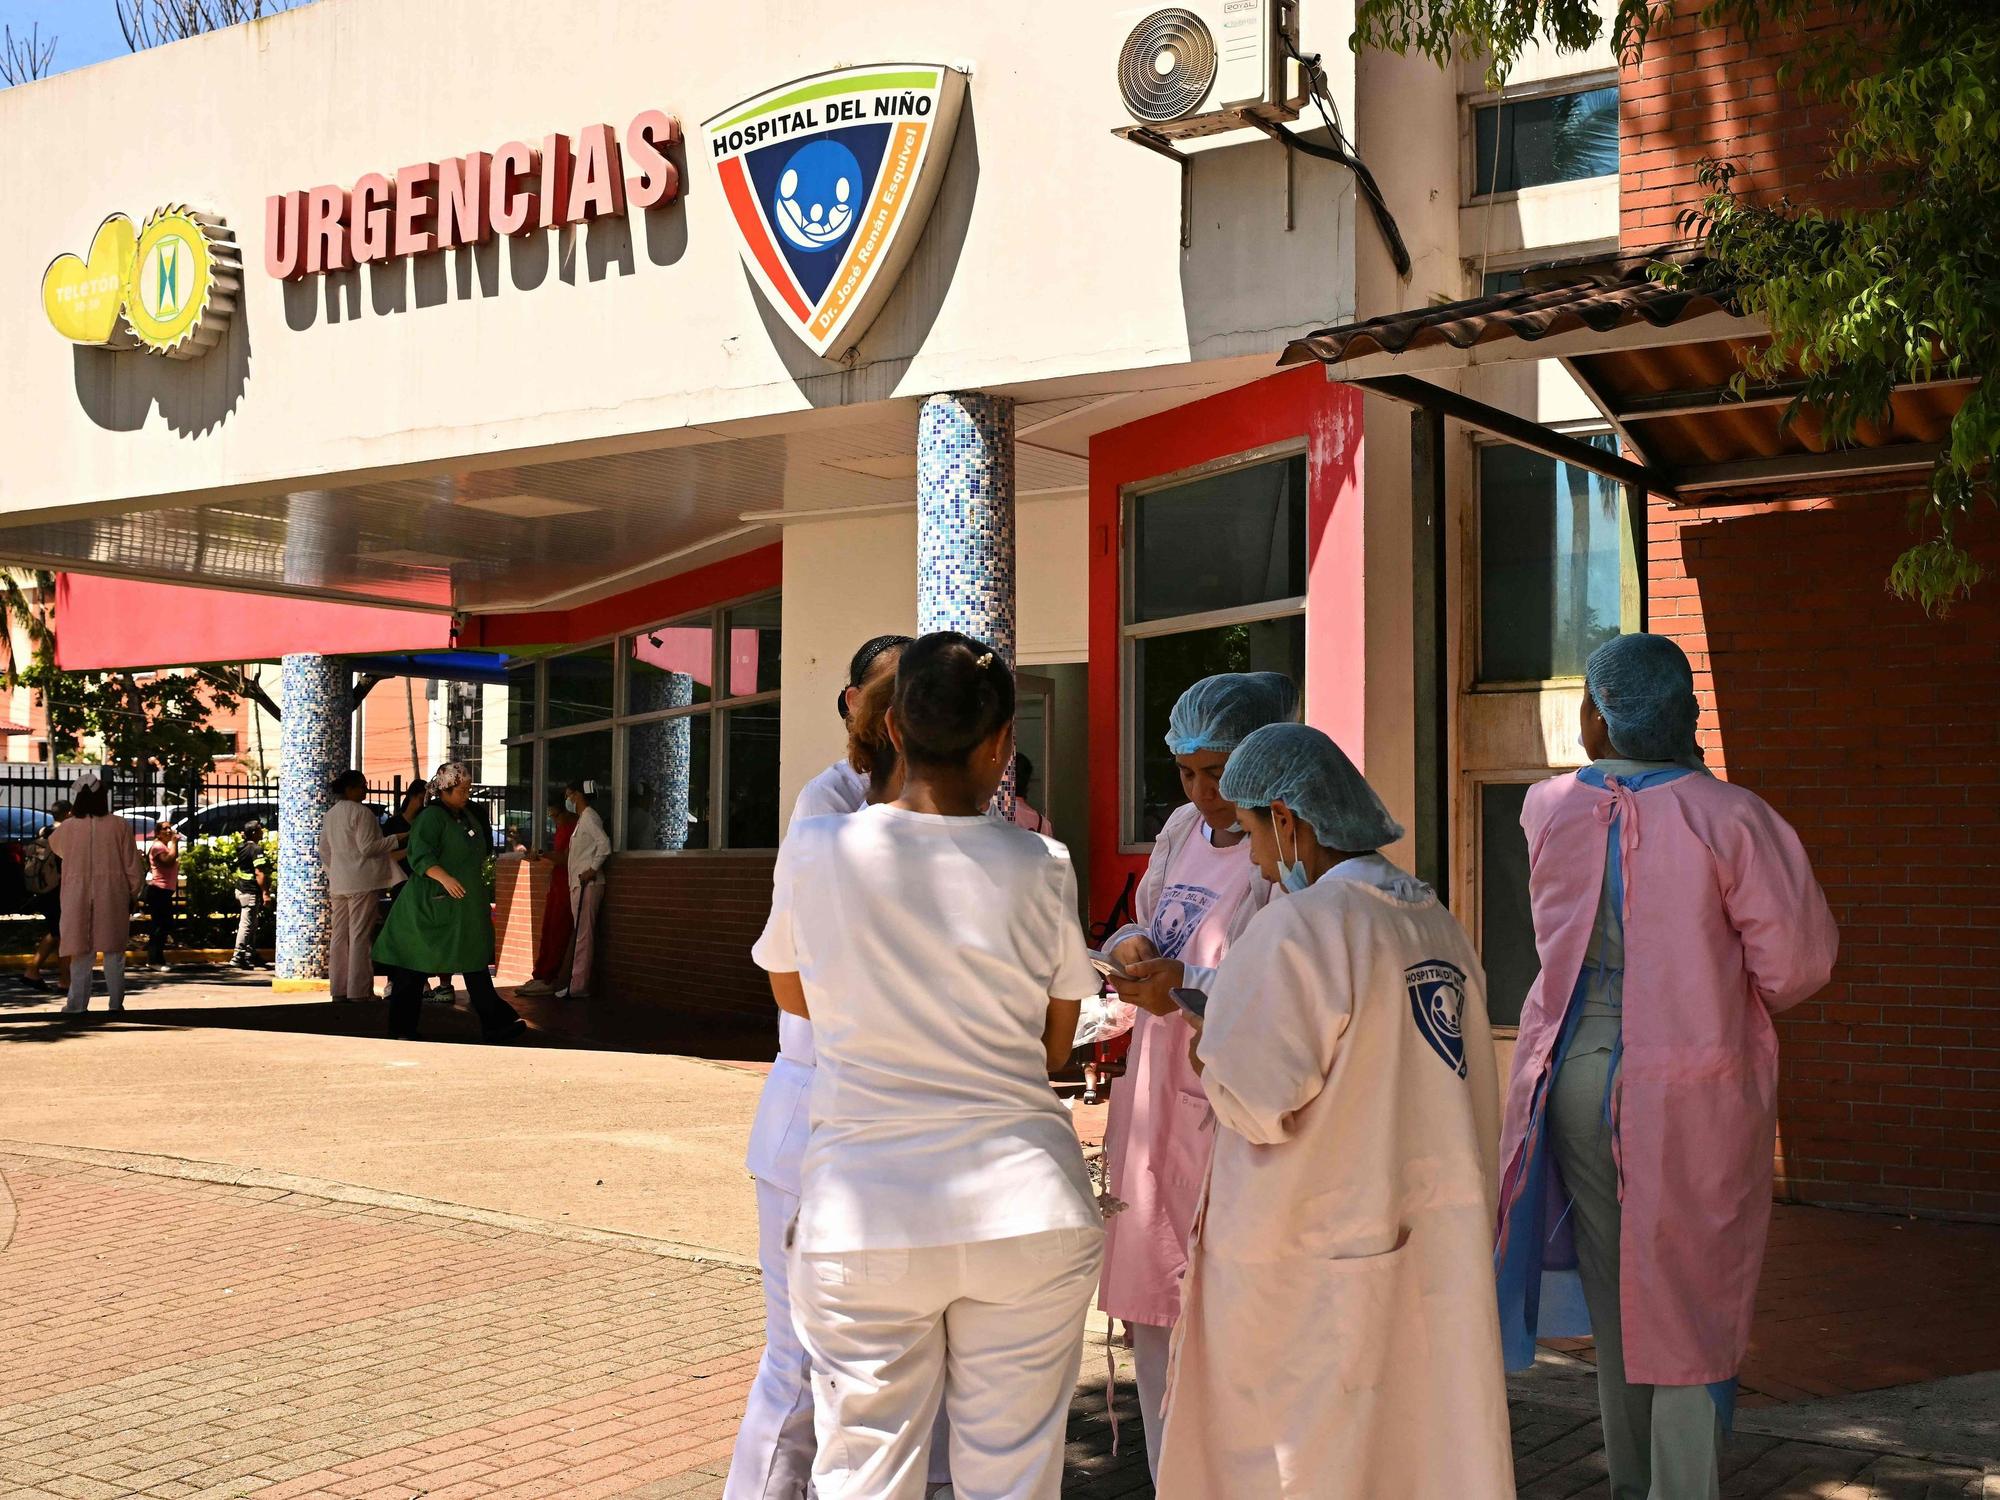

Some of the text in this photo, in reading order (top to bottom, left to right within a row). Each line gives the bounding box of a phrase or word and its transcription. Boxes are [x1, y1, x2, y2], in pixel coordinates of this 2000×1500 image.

[265, 109, 678, 282] URGENCIAS
[712, 91, 932, 158] HOSPITAL DEL NIÑO
[818, 128, 918, 330] Dr. José Renán Esquivel
